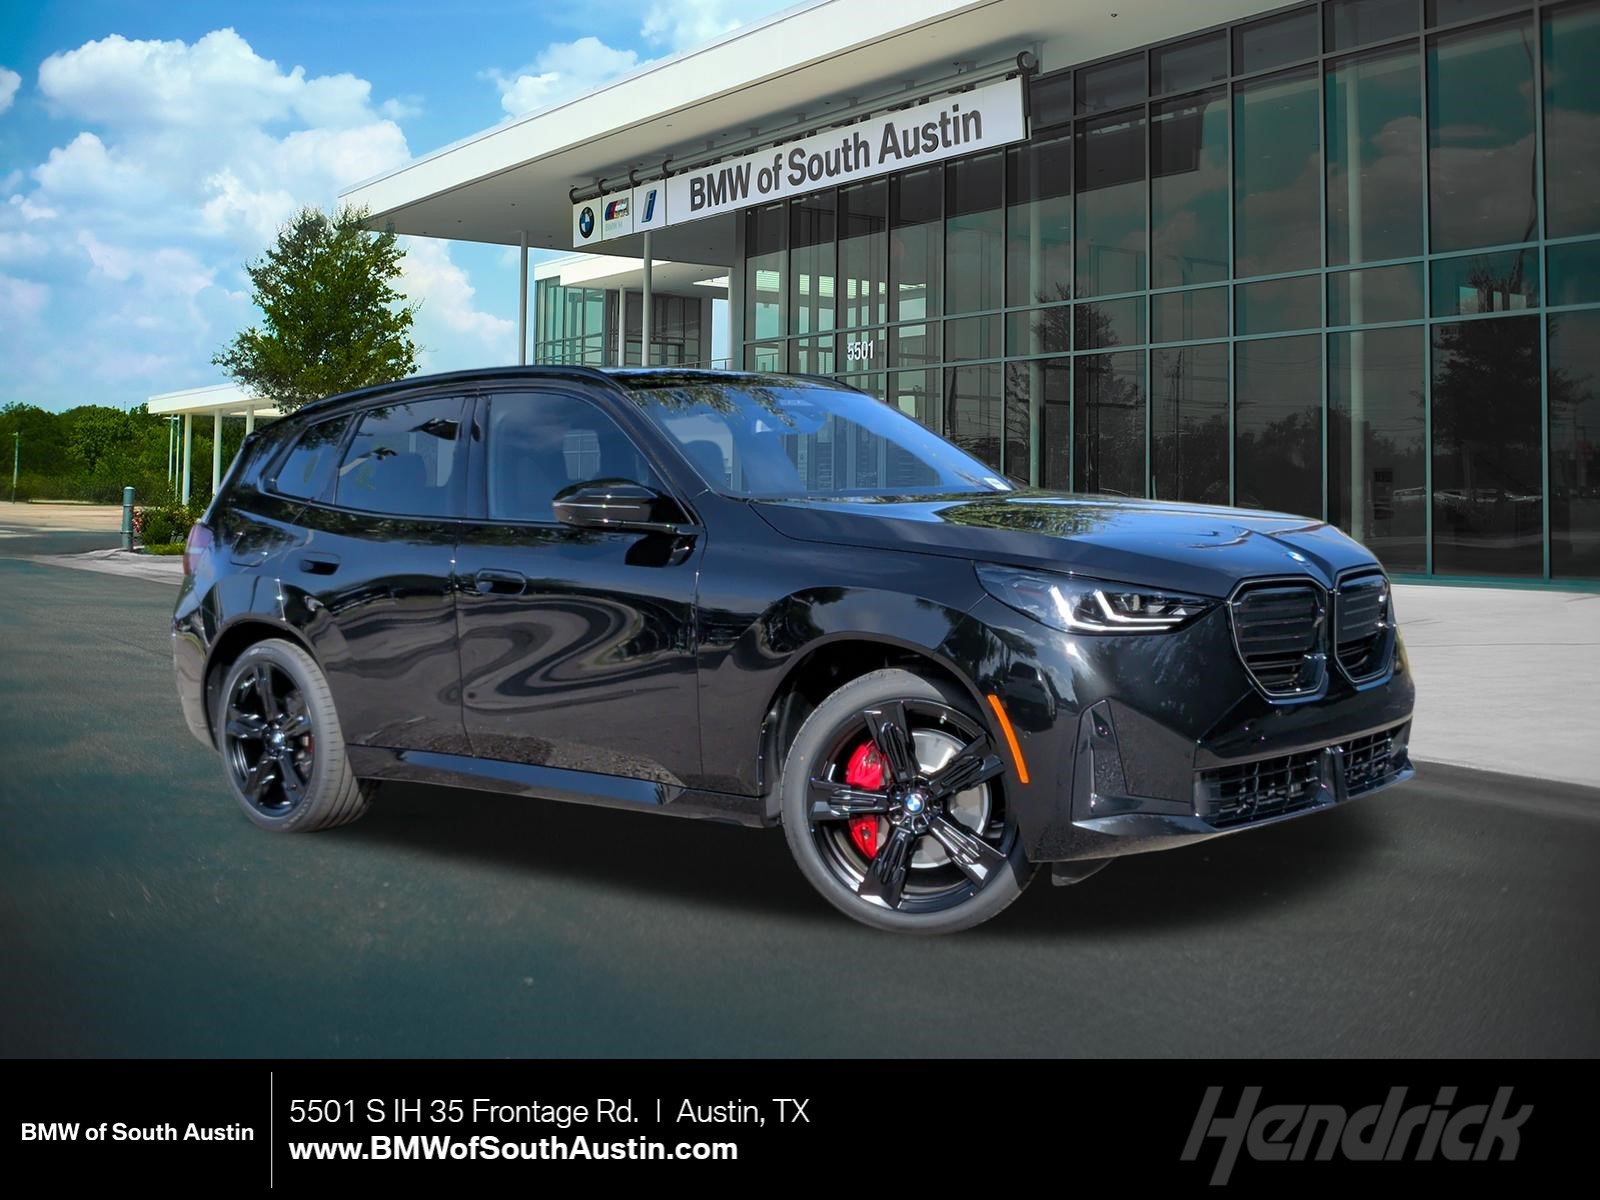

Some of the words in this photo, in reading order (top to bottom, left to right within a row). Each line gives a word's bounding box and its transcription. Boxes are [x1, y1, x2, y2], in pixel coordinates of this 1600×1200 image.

[690, 162, 751, 212] BMW
[757, 153, 783, 194] of
[787, 131, 870, 187] South
[878, 103, 982, 164] Austin
[847, 340, 874, 361] 5501
